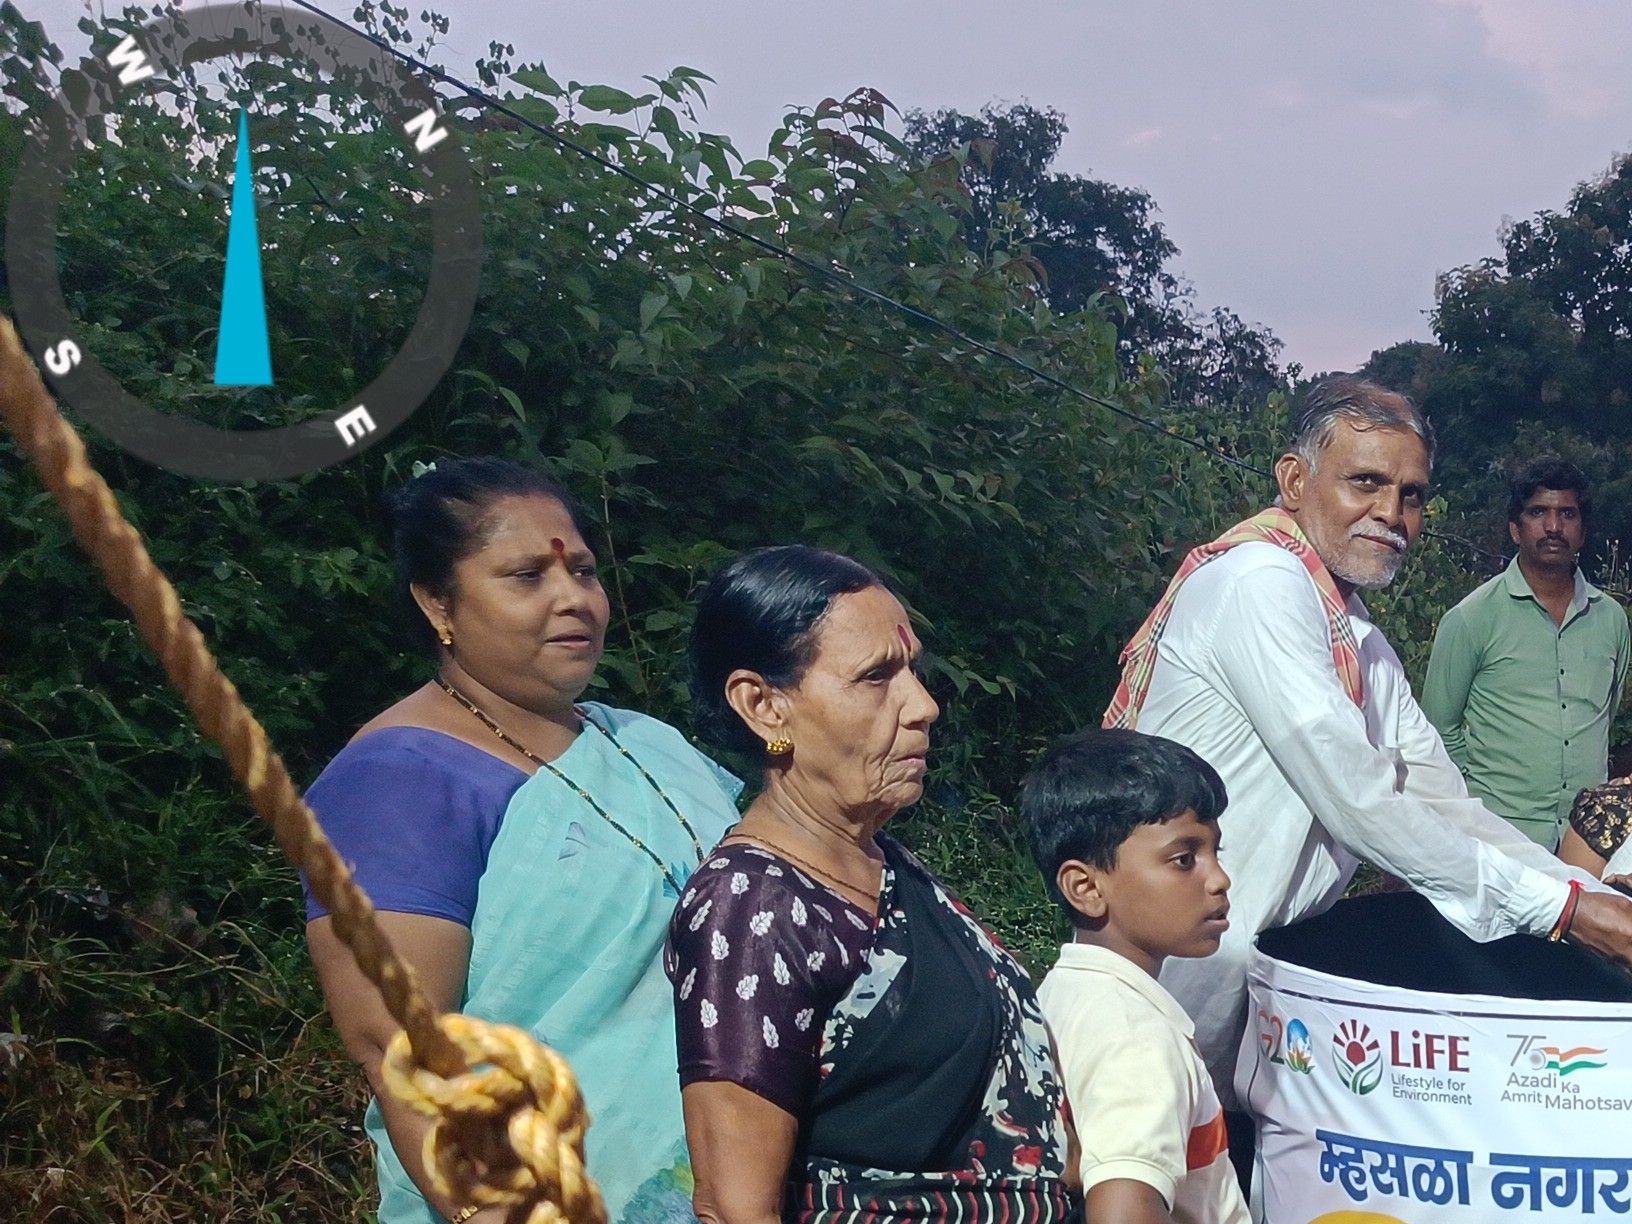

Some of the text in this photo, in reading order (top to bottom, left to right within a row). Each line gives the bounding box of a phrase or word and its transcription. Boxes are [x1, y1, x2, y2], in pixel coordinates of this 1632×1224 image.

[1390, 1029, 1470, 1073] LiFE
[1391, 1073, 1466, 1091] Lifestyle for
[1506, 1072, 1580, 1093] Azadi Ka
[1392, 1085, 1473, 1106] Environment
[1500, 1089, 1542, 1104] Amrit
[1315, 1128, 1474, 1206] म्हसळा
